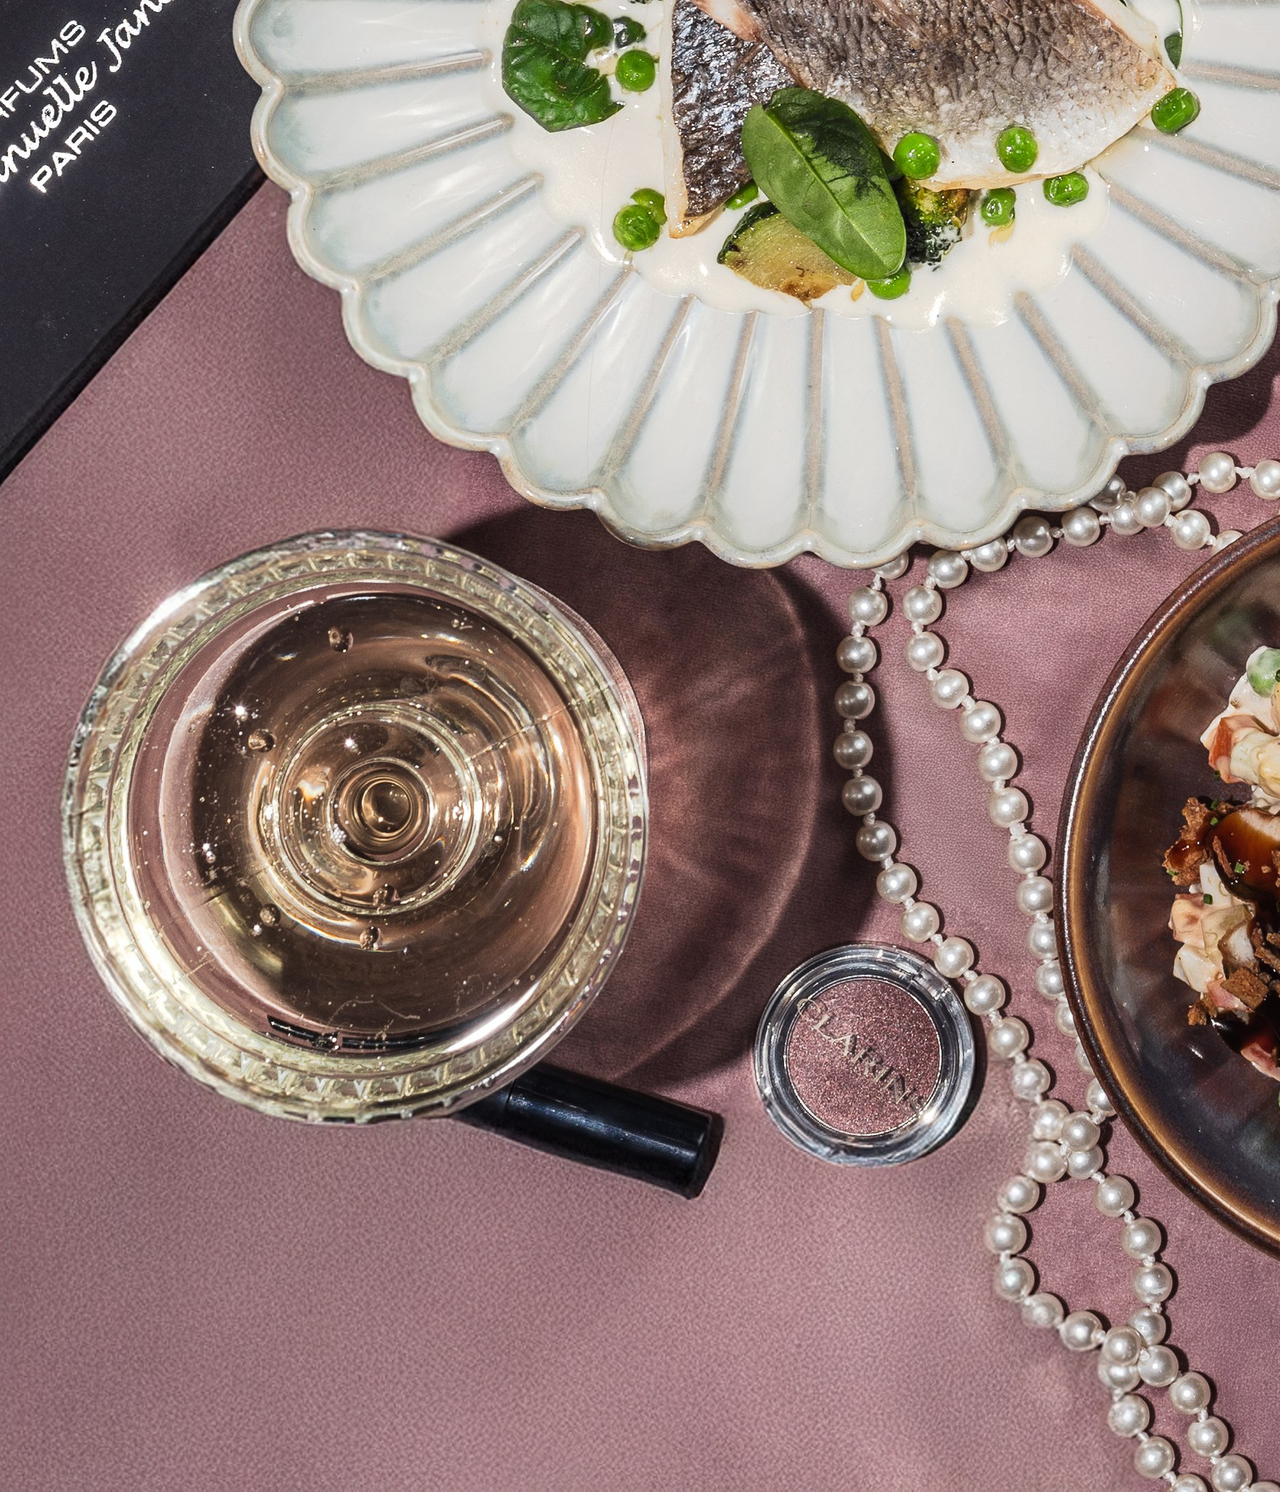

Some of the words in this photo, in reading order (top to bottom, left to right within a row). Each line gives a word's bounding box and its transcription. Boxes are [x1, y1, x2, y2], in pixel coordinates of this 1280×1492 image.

[0, 20, 86, 118] FUMS
[0, 61, 97, 182] nuelle
[30, 100, 117, 193] PARIS
